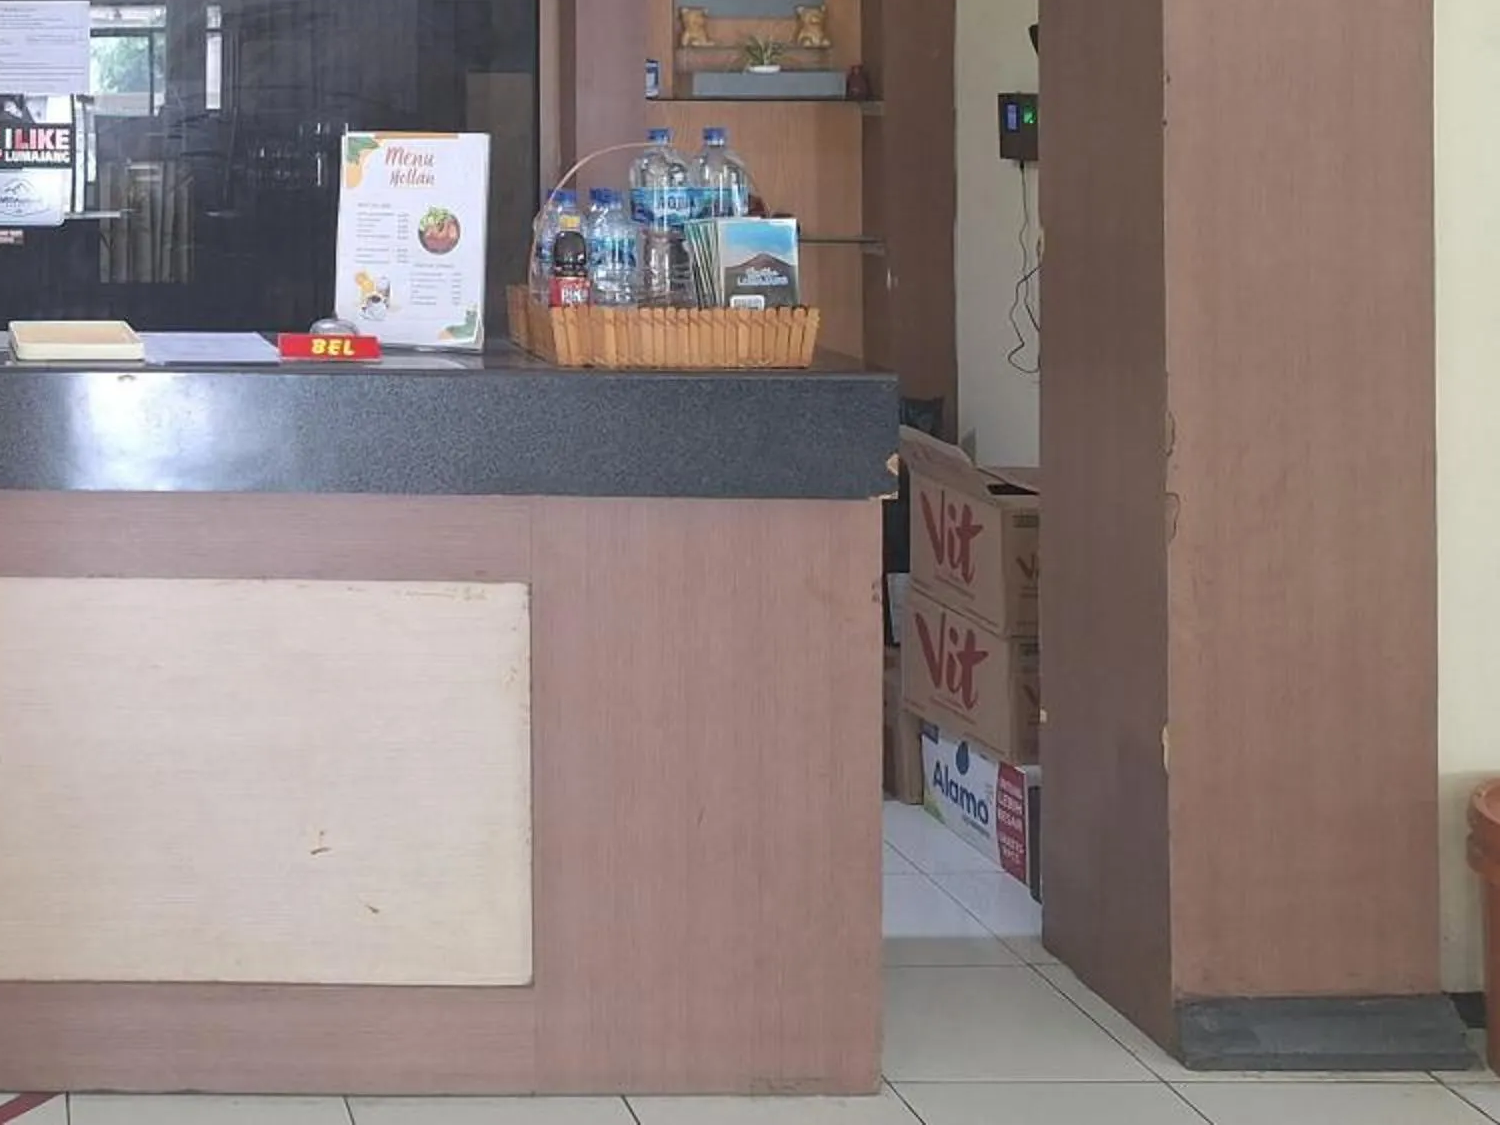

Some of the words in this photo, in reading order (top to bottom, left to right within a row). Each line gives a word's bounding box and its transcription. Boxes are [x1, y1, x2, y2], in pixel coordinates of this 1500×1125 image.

[5, 128, 13, 150] I
[14, 128, 70, 150] LIKE
[385, 146, 435, 168] Menu
[311, 338, 356, 356] BEL
[919, 489, 984, 585] Vit
[915, 611, 989, 711] Vit
[932, 759, 989, 825] Alamo
